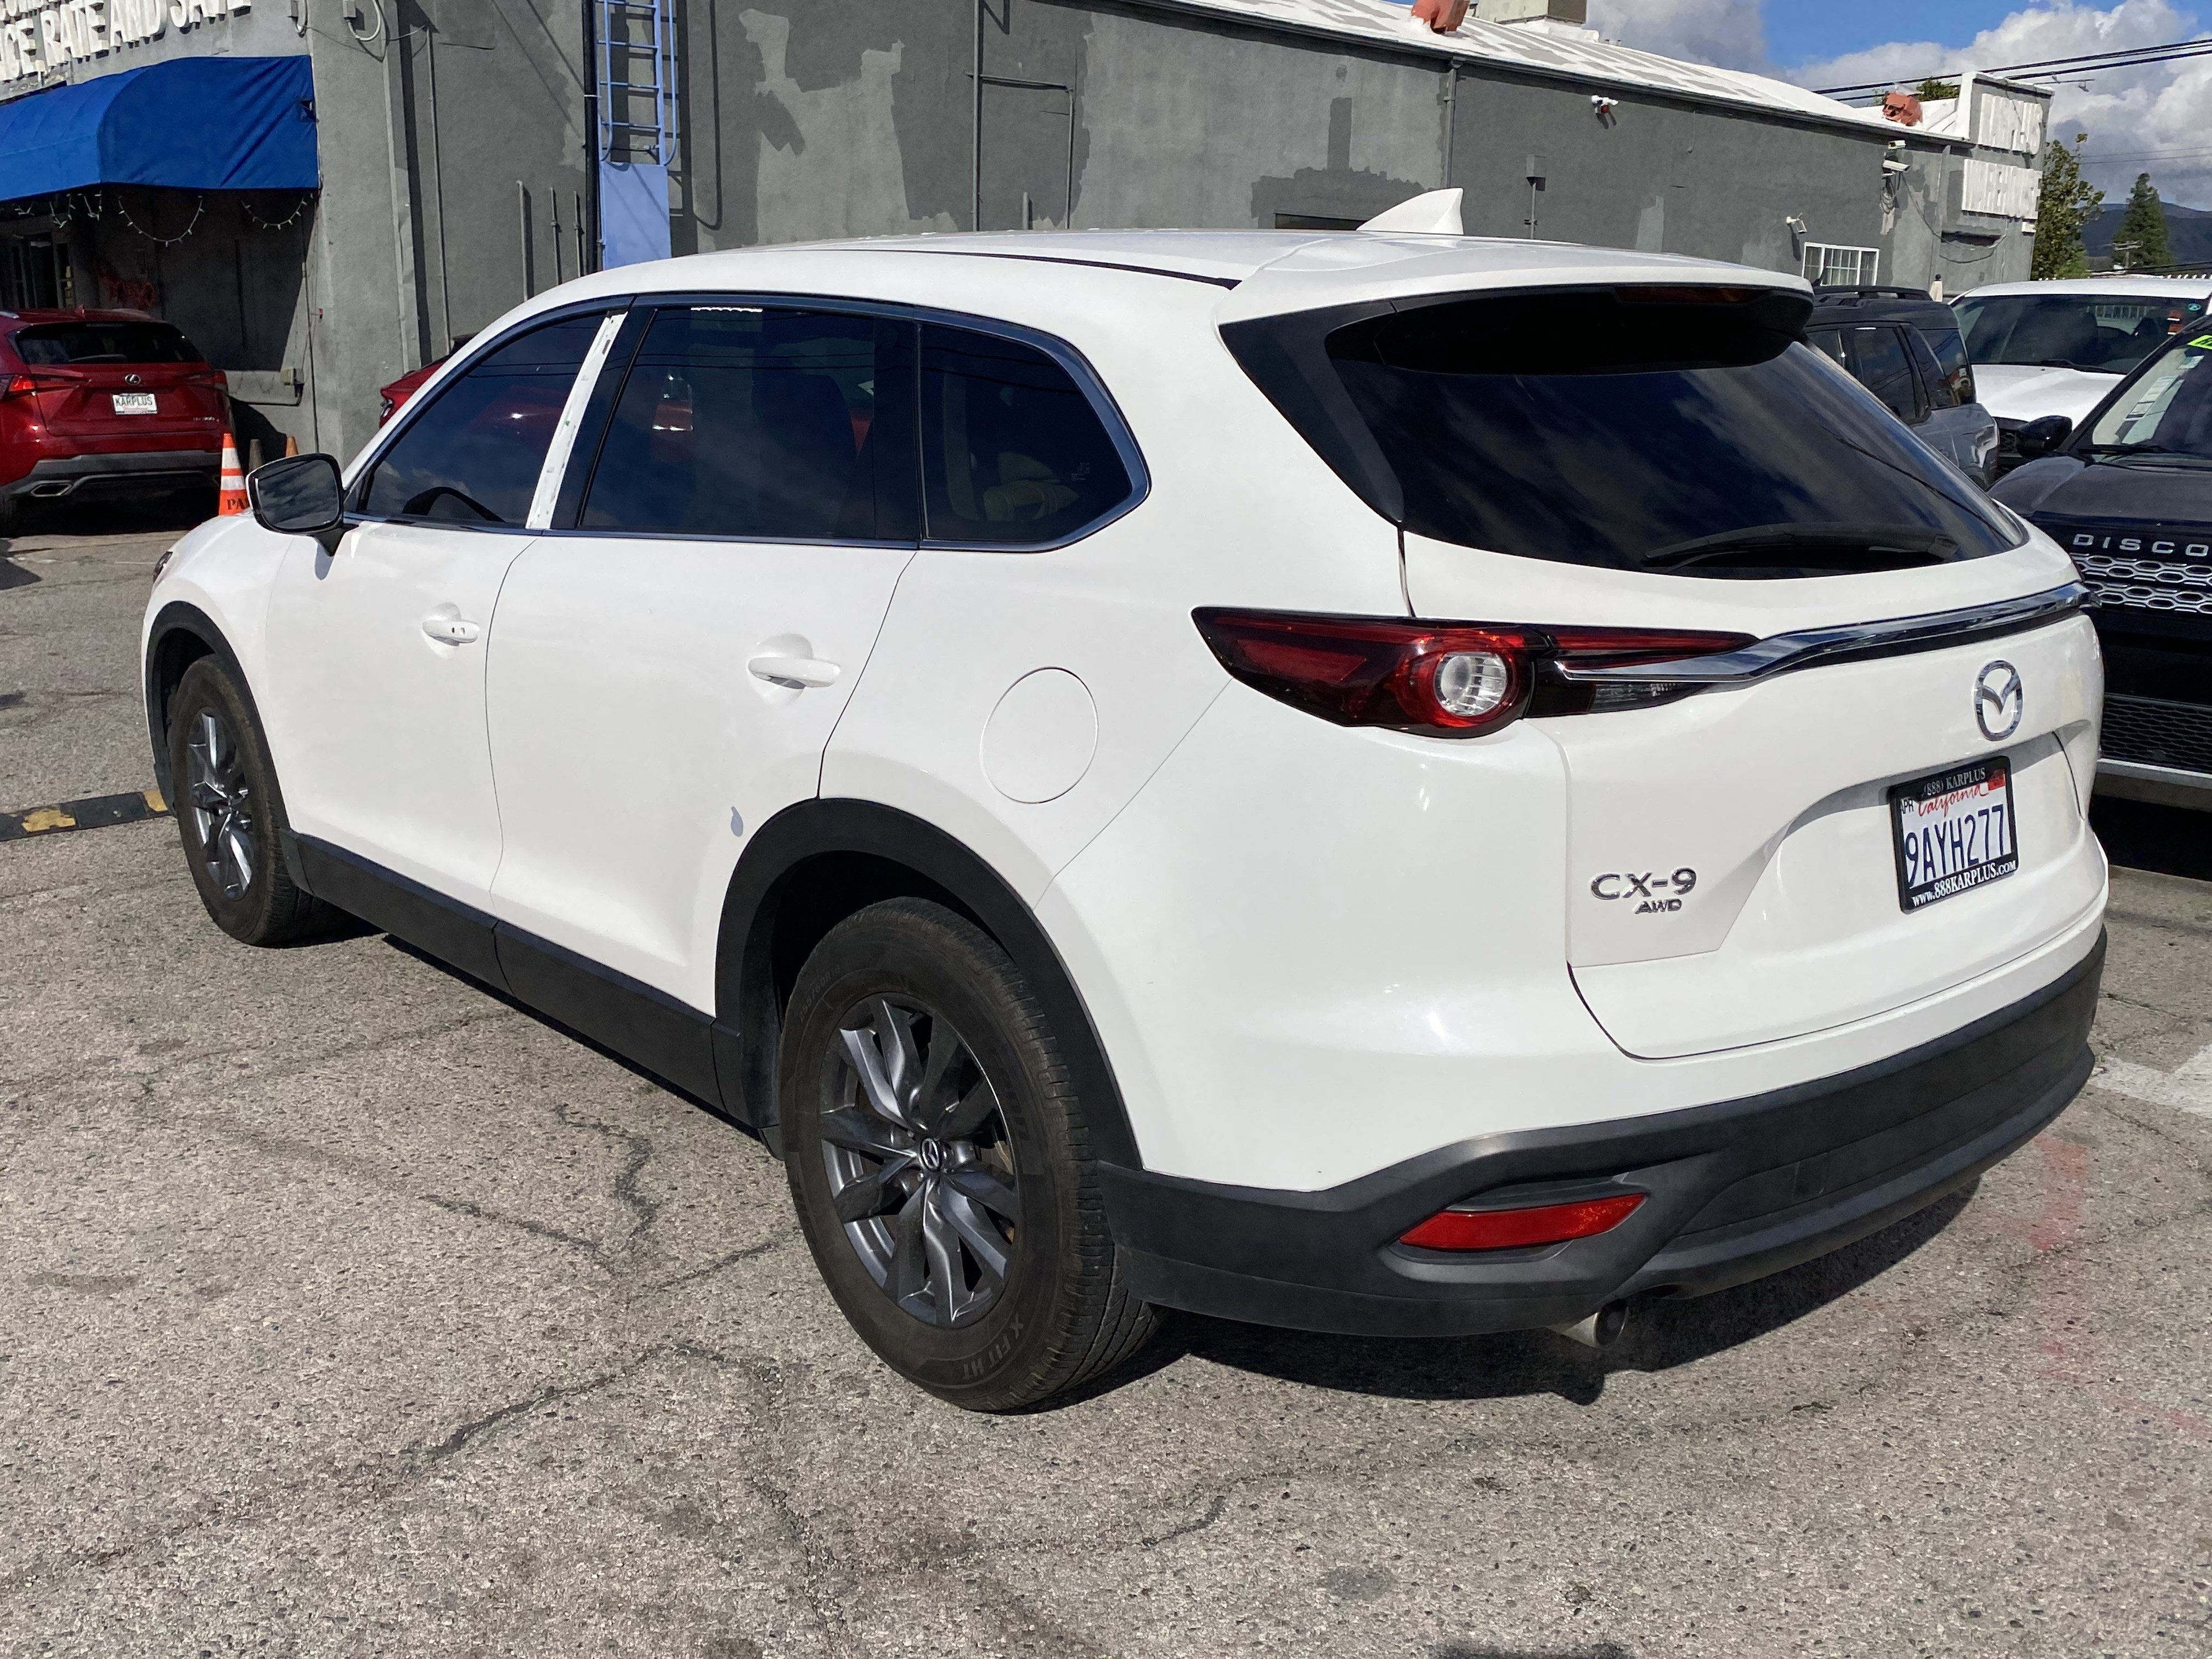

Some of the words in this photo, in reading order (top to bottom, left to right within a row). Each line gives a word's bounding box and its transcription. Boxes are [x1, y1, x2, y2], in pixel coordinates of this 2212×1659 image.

[40, 0, 109, 66] RATE
[116, 396, 153, 407] KARPLUS
[2073, 534, 2209, 557] DISCO
[1923, 781, 1944, 796] (888)
[1946, 767, 1986, 788] KARPLUS
[1918, 783, 1989, 817] California
[1905, 803, 2004, 887] 9AYH277
[1591, 867, 1696, 900] CX-9
[1633, 898, 1682, 915] AWD
[1009, 1311, 1025, 1340] X
[989, 1334, 1011, 1369] FIT
[962, 1358, 985, 1379] HT
